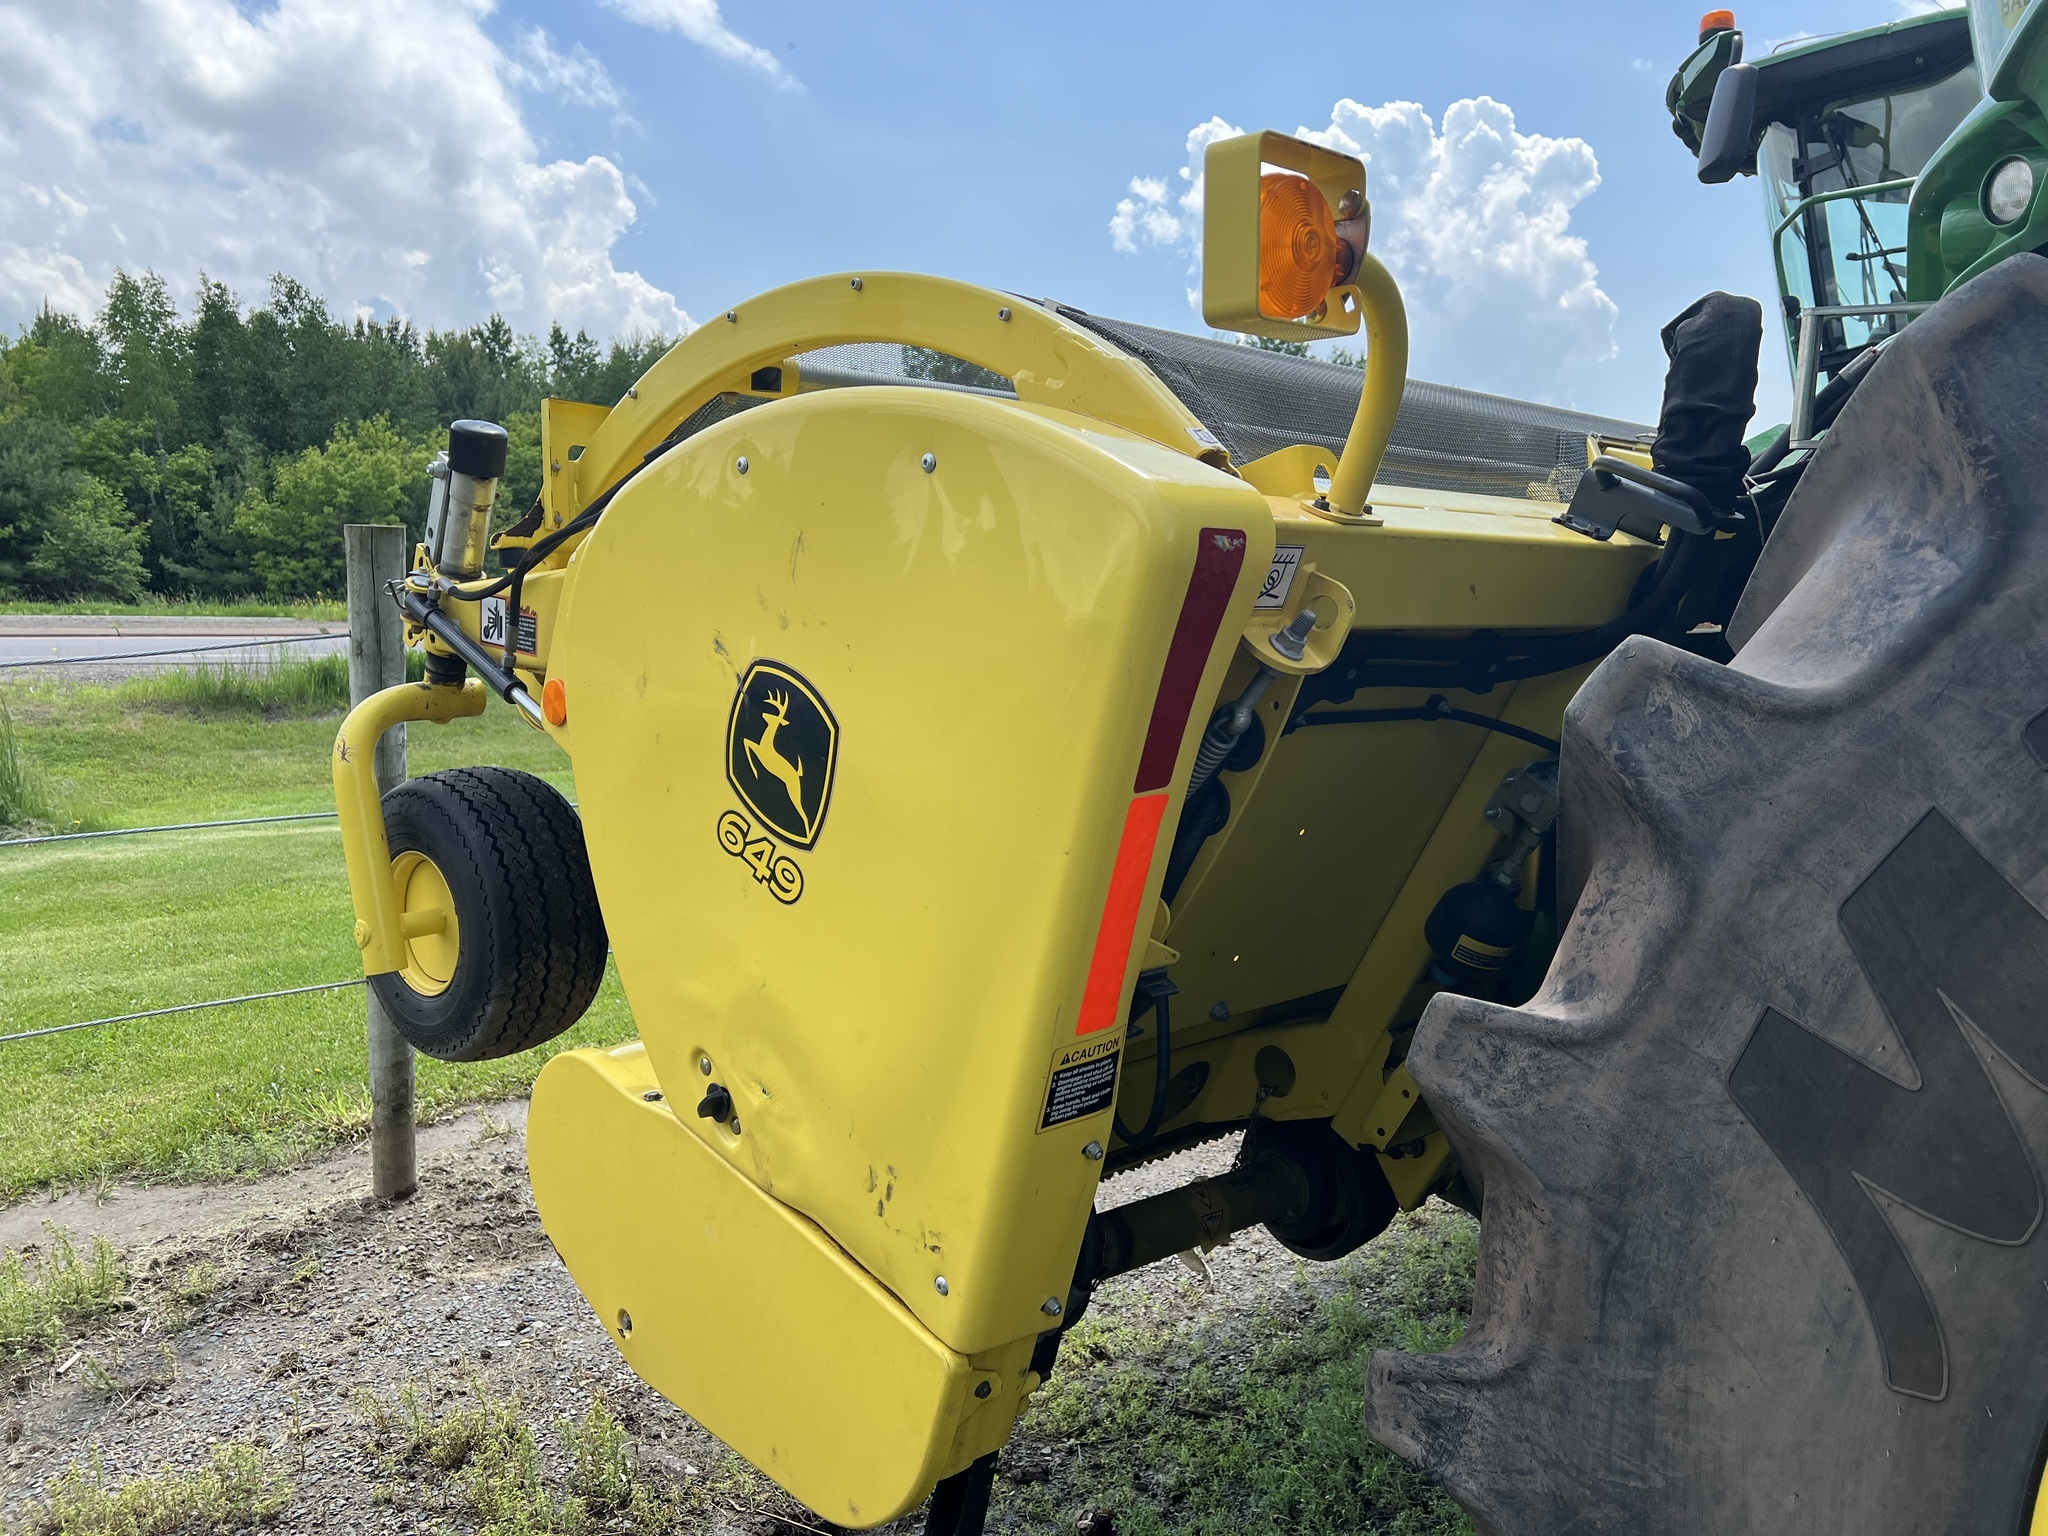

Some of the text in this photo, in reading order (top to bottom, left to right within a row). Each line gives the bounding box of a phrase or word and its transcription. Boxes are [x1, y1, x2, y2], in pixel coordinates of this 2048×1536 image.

[717, 809, 804, 905] 649
[1071, 1036, 1120, 1062] CAUTION
[1058, 1075, 1082, 1086] Disengage
[1093, 1067, 1102, 1076] shut
[1059, 1071, 1072, 1079] Keep
[1079, 1064, 1095, 1073] shields
[1100, 1058, 1112, 1067] place.
[1056, 1068, 1115, 1092] engine and/or motor power
[1053, 1090, 1086, 1104] ging machine.
[1055, 1089, 1070, 1098] before
[1071, 1082, 1091, 1093] servicing
[1052, 1103, 1065, 1111] Keep
[1081, 1094, 1091, 1102] feet
[1091, 1091, 1100, 1099] and
[1059, 1106, 1072, 1114] away
[1049, 1110, 1078, 1123] driven parts.
